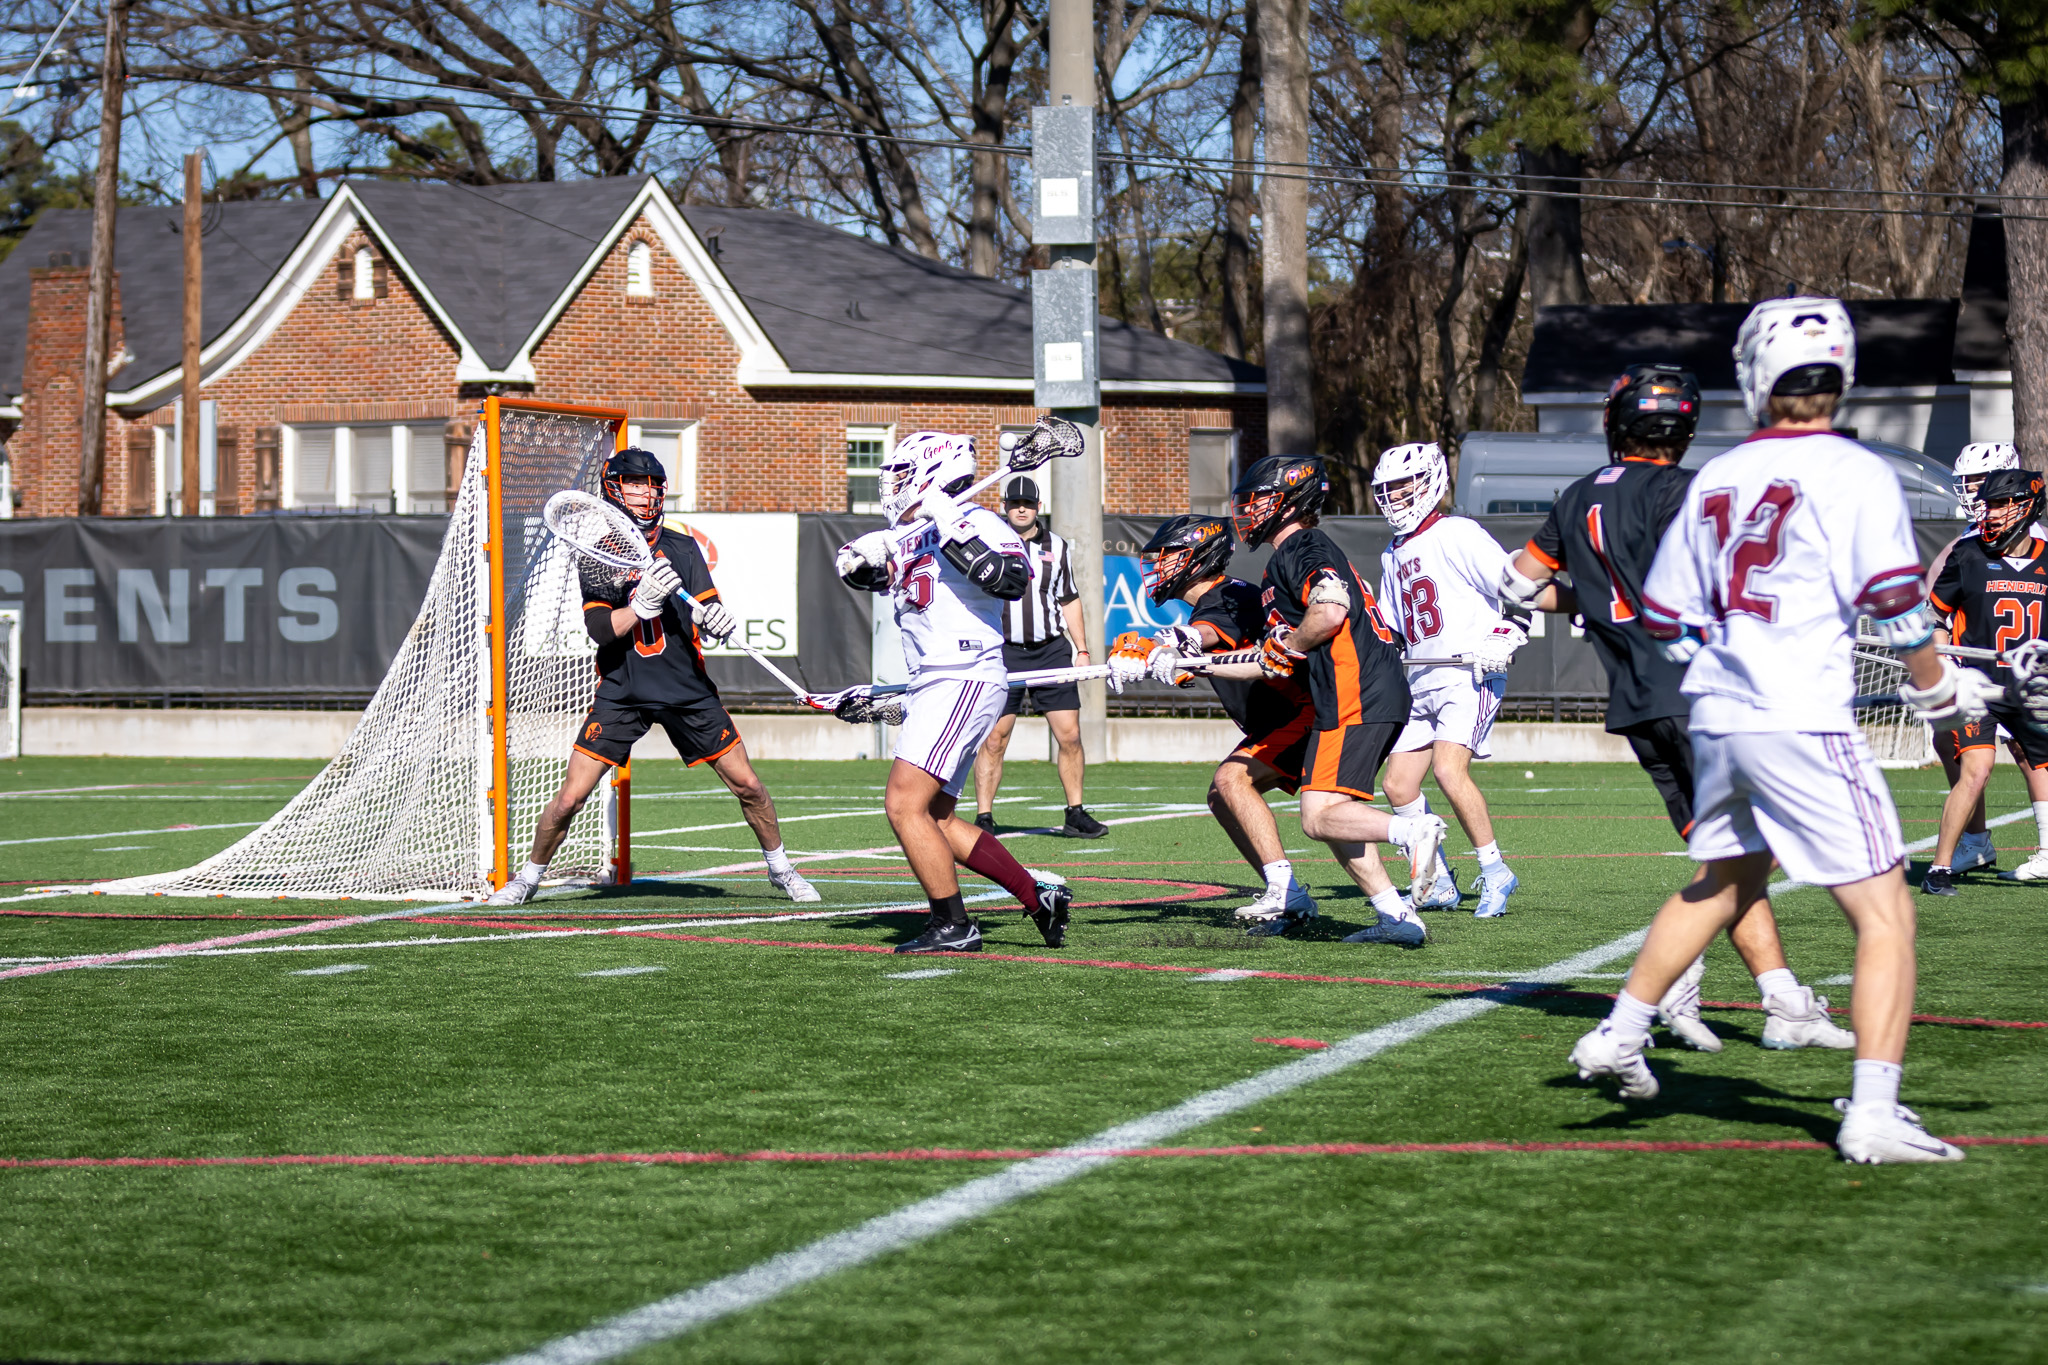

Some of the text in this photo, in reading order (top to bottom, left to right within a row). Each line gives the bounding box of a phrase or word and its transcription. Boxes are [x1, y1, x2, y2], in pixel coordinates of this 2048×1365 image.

[978, 562, 996, 581] STX
[1586, 503, 1638, 623] 1
[1700, 478, 1801, 624] 12
[1985, 579, 2048, 596] HENDRIX
[1993, 597, 2043, 668] 21
[1269, 649, 1289, 666] STX
